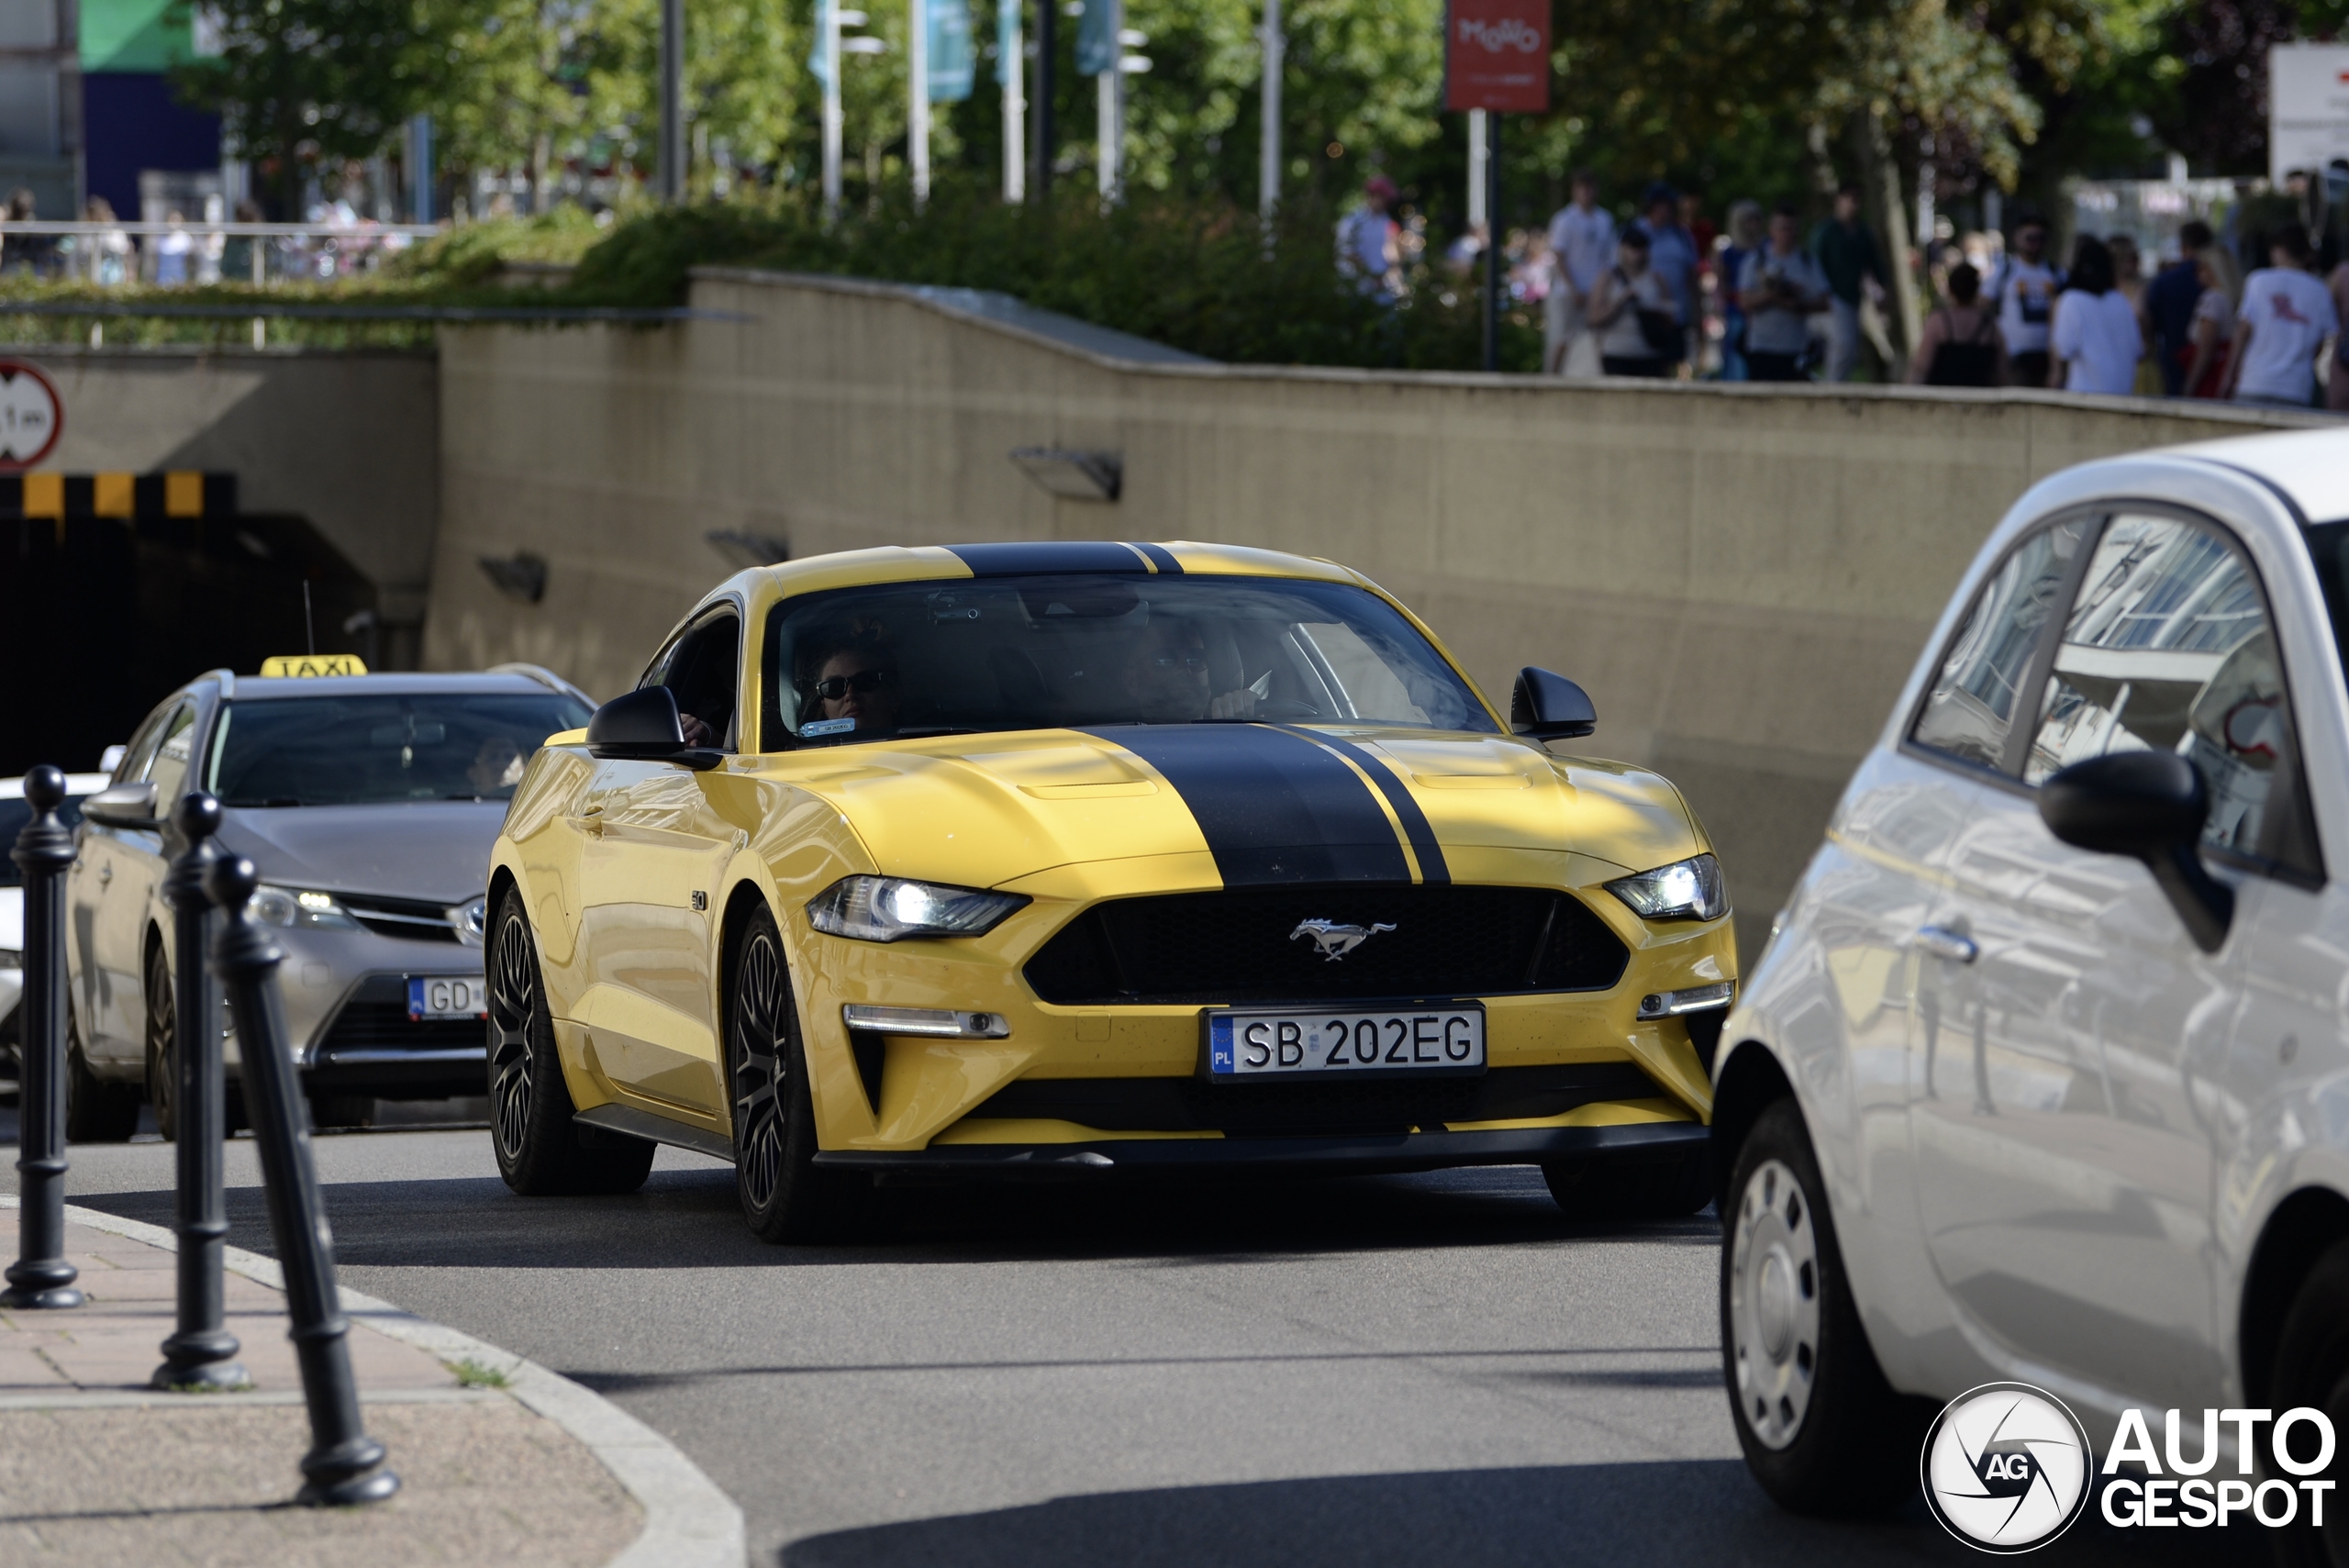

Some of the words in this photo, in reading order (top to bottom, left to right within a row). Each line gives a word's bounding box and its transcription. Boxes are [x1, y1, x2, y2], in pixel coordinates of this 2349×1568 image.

[275, 660, 351, 677] TAXI
[432, 980, 470, 1011] GD
[1244, 1021, 1304, 1068] SB
[1325, 1016, 1471, 1065] 202EG
[1215, 1052, 1231, 1065] PL
